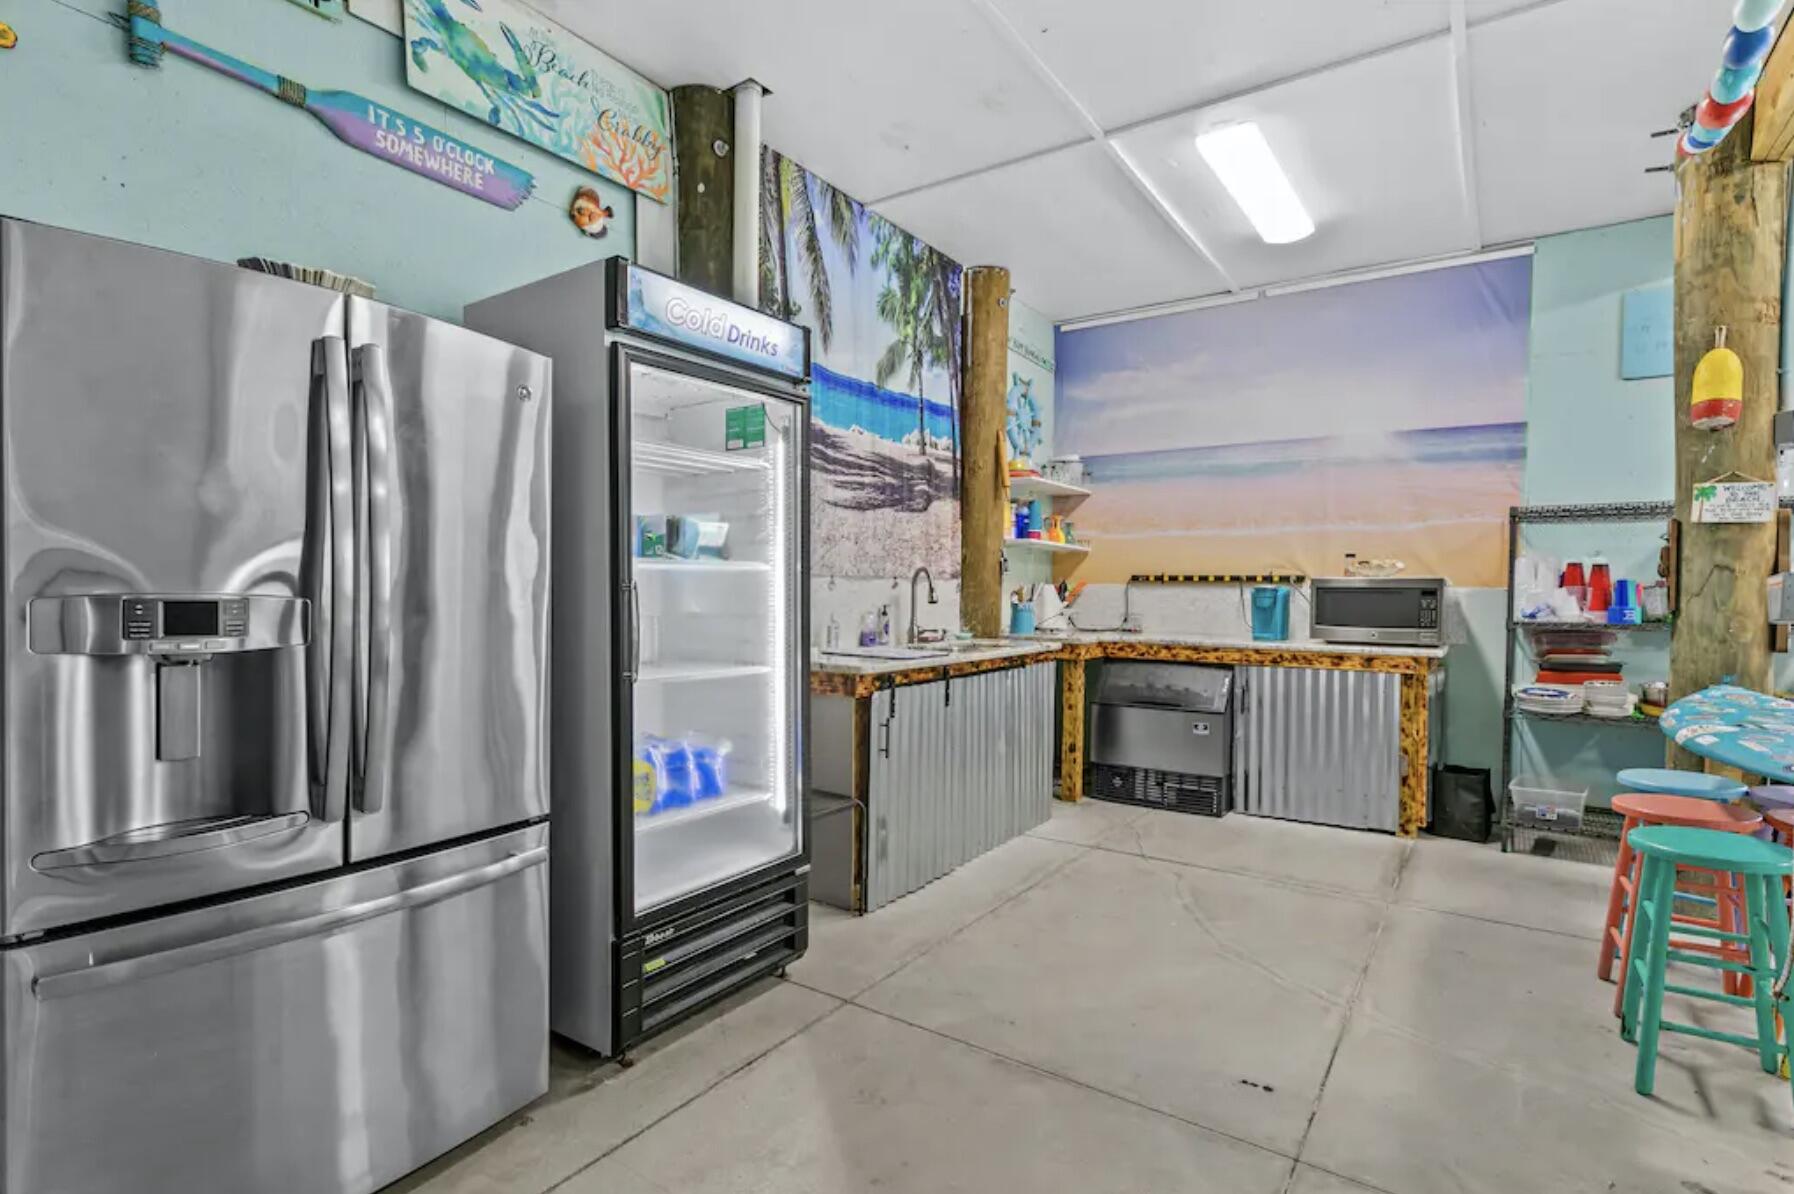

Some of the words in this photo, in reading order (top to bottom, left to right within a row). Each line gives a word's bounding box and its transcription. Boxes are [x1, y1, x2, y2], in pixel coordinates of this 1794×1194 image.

[376, 130, 484, 190] SOMEWHERE
[413, 126, 426, 145] 5
[433, 135, 495, 175] O'CLOCK
[665, 297, 728, 339] Cold
[727, 324, 778, 357] Drinks
